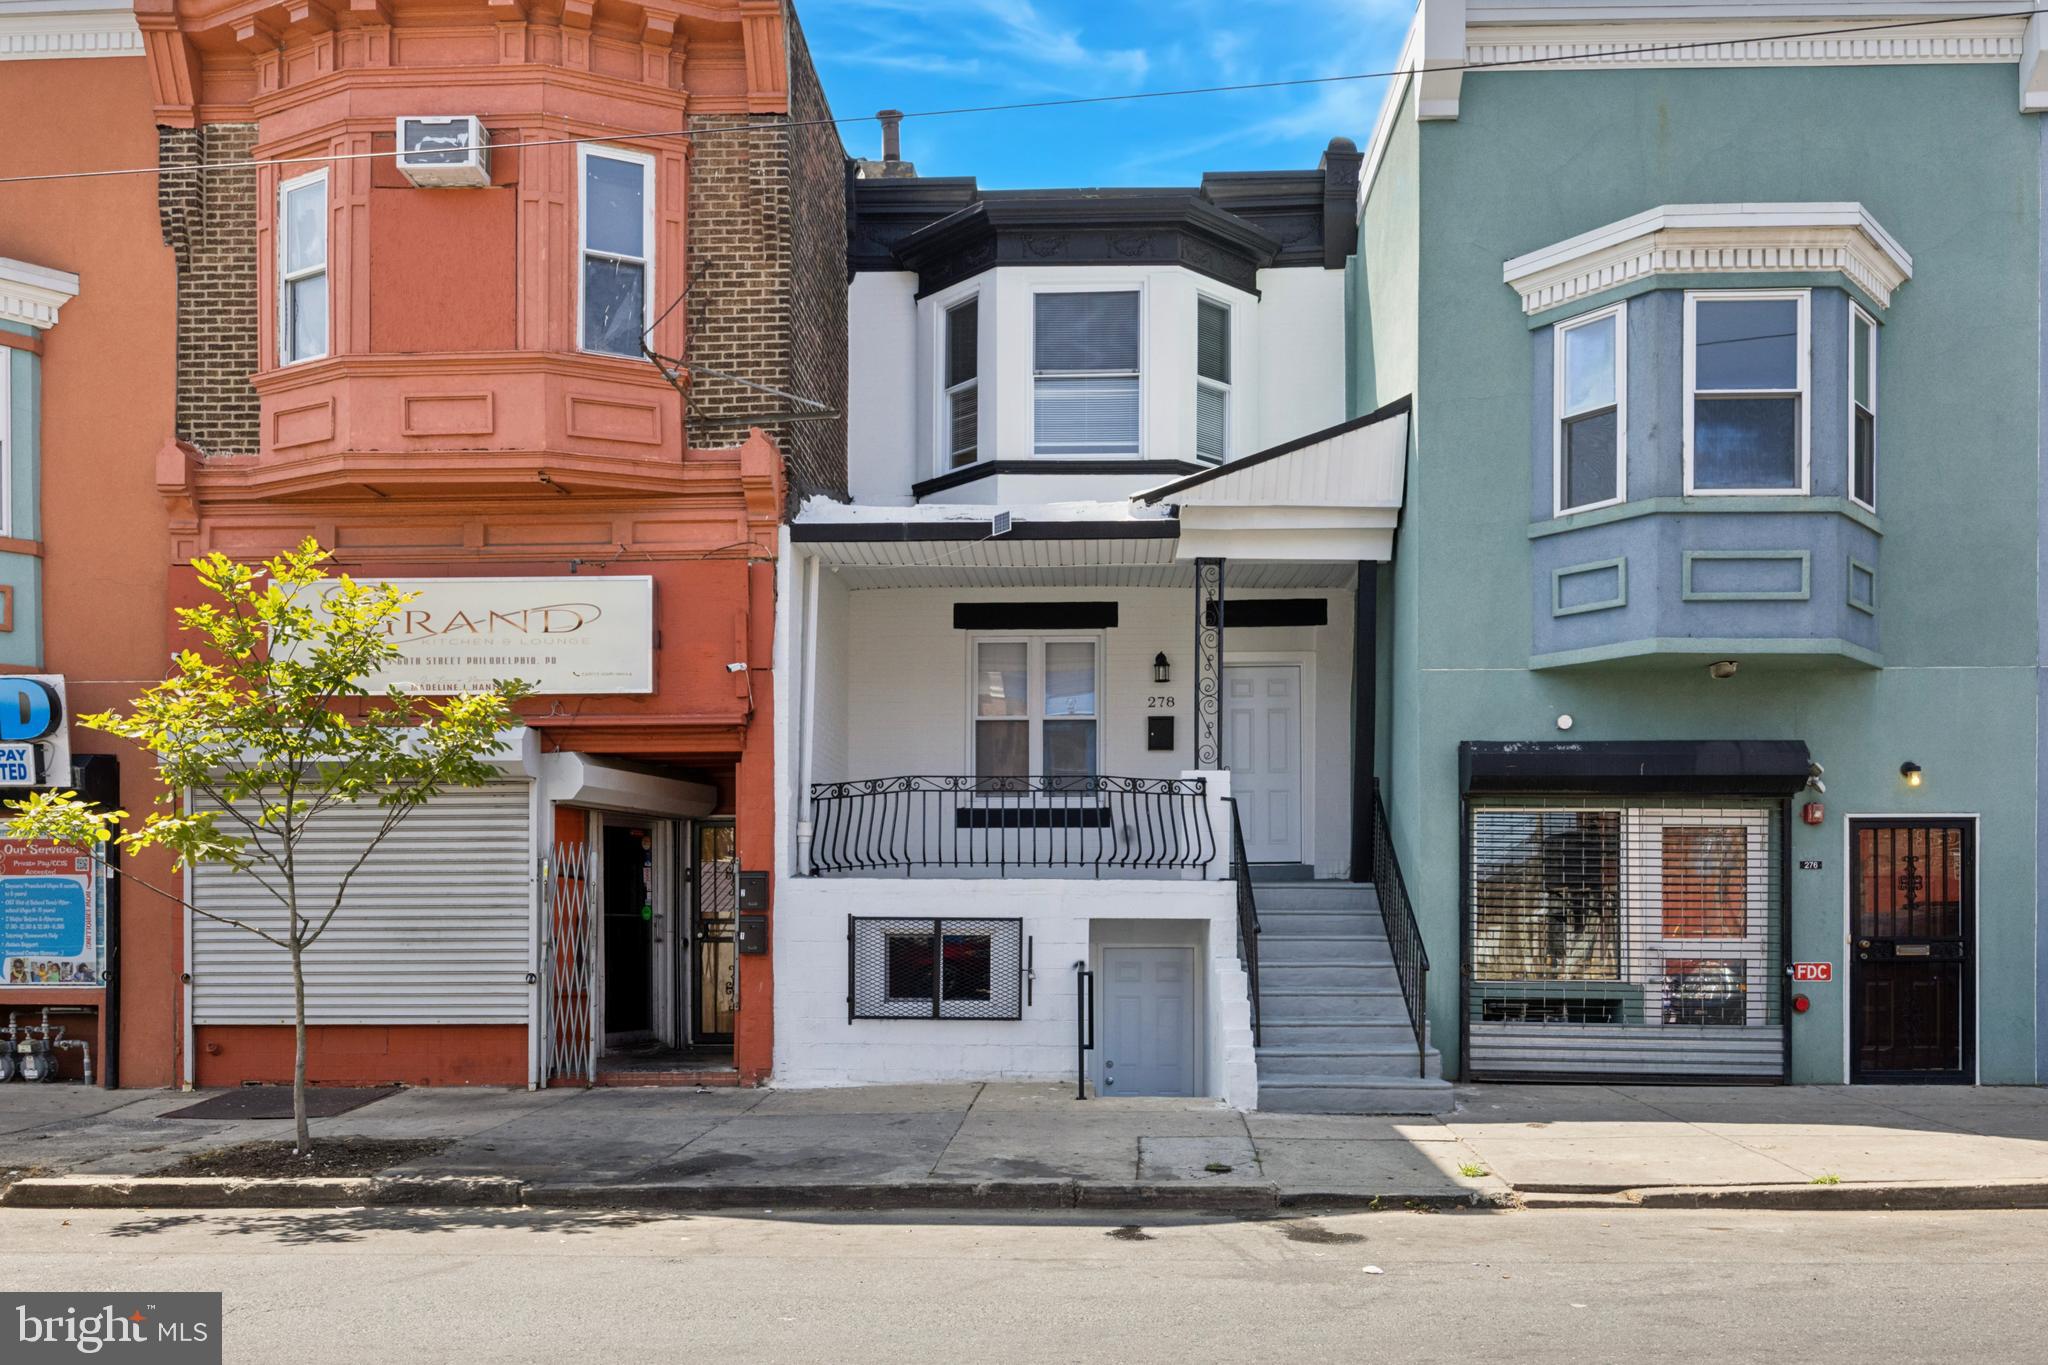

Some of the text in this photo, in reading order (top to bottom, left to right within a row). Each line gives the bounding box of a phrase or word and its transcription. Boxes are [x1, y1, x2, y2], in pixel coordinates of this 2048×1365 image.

[421, 638, 494, 646] KITCHEN
[520, 638, 590, 646] LOUNGE
[426, 657, 461, 665] STREET
[1147, 696, 1175, 708] 278
[4, 843, 79, 855] Our Services
[1804, 861, 1818, 869] 276
[1797, 964, 1827, 979] FDC
